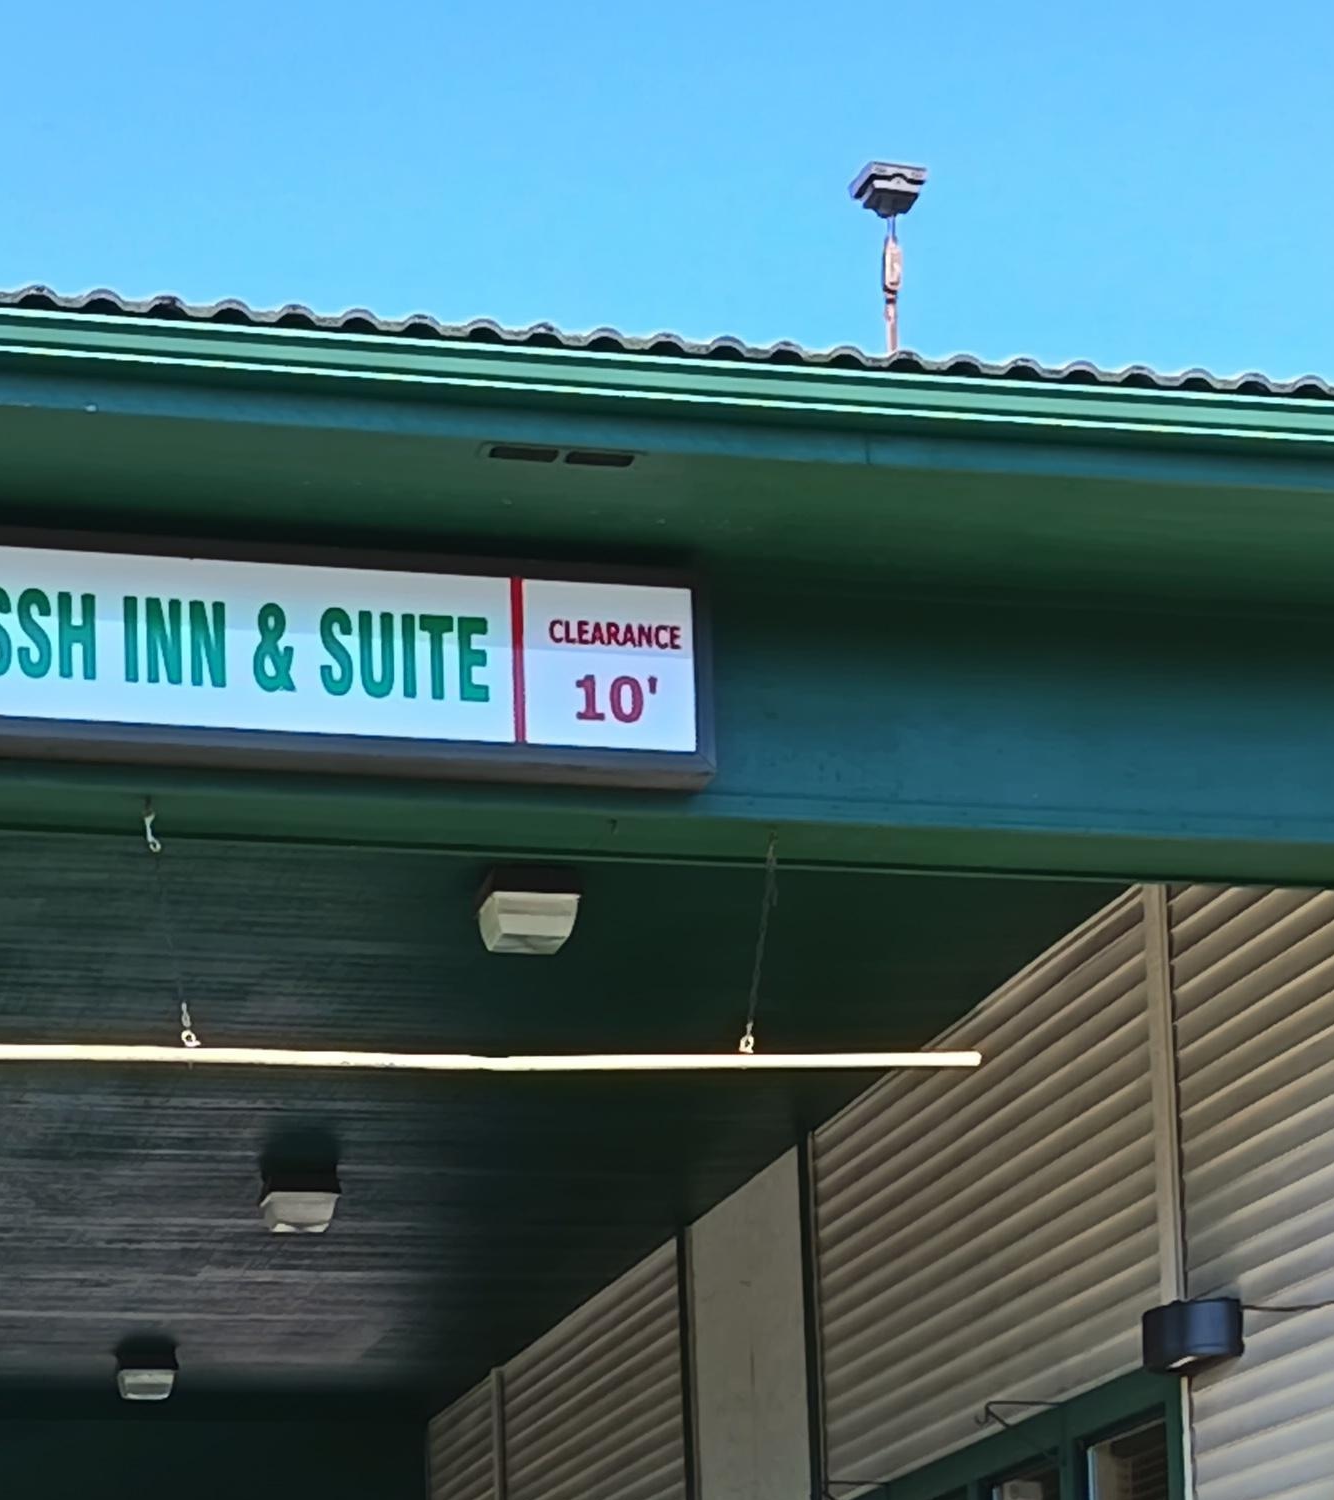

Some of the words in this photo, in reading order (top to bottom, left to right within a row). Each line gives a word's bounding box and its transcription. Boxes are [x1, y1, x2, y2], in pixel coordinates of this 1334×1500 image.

[124, 596, 227, 688] INN
[253, 602, 296, 693] &
[319, 606, 490, 703] SUITE
[547, 618, 682, 651] CLEARANCE
[574, 673, 659, 723] 10'
